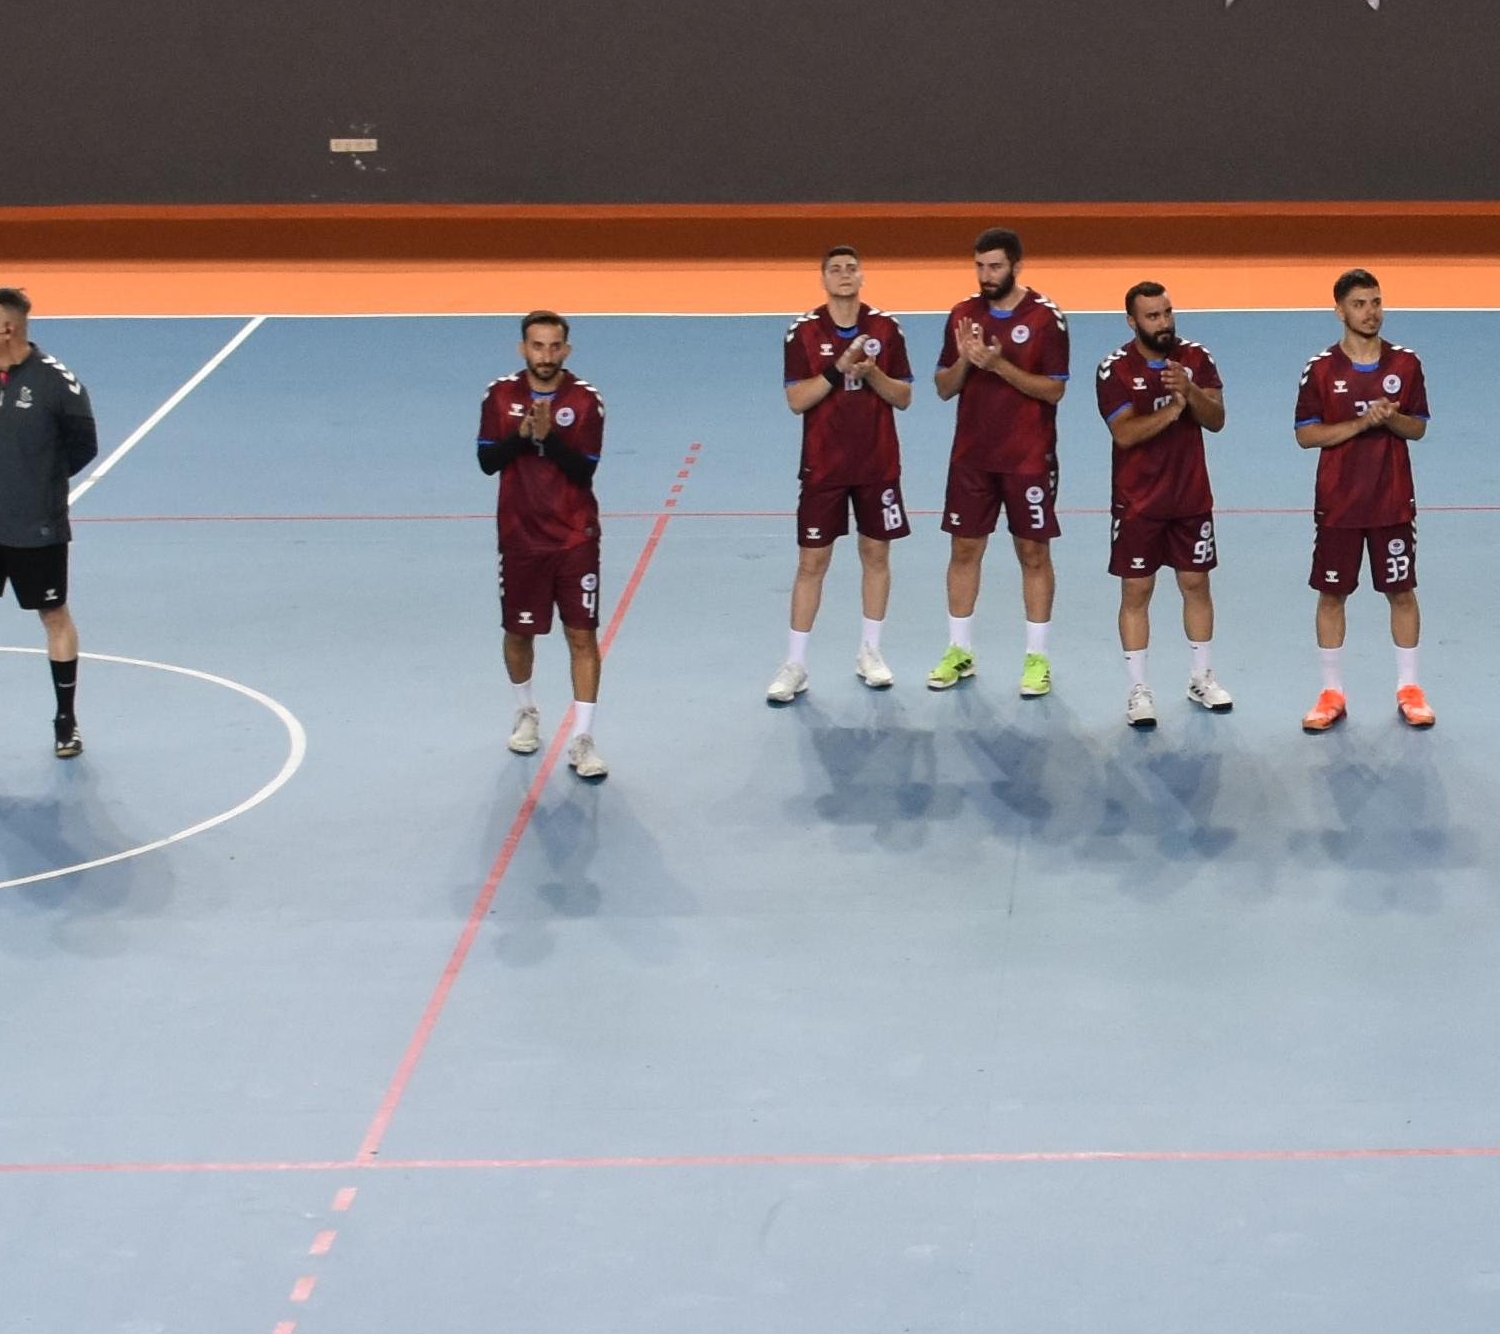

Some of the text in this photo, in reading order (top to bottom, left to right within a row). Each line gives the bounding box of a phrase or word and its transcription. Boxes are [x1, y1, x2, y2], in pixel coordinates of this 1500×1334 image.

[881, 503, 903, 532] 18
[1028, 504, 1045, 530] 3
[1385, 555, 1410, 584] 33
[582, 592, 597, 618] 4
